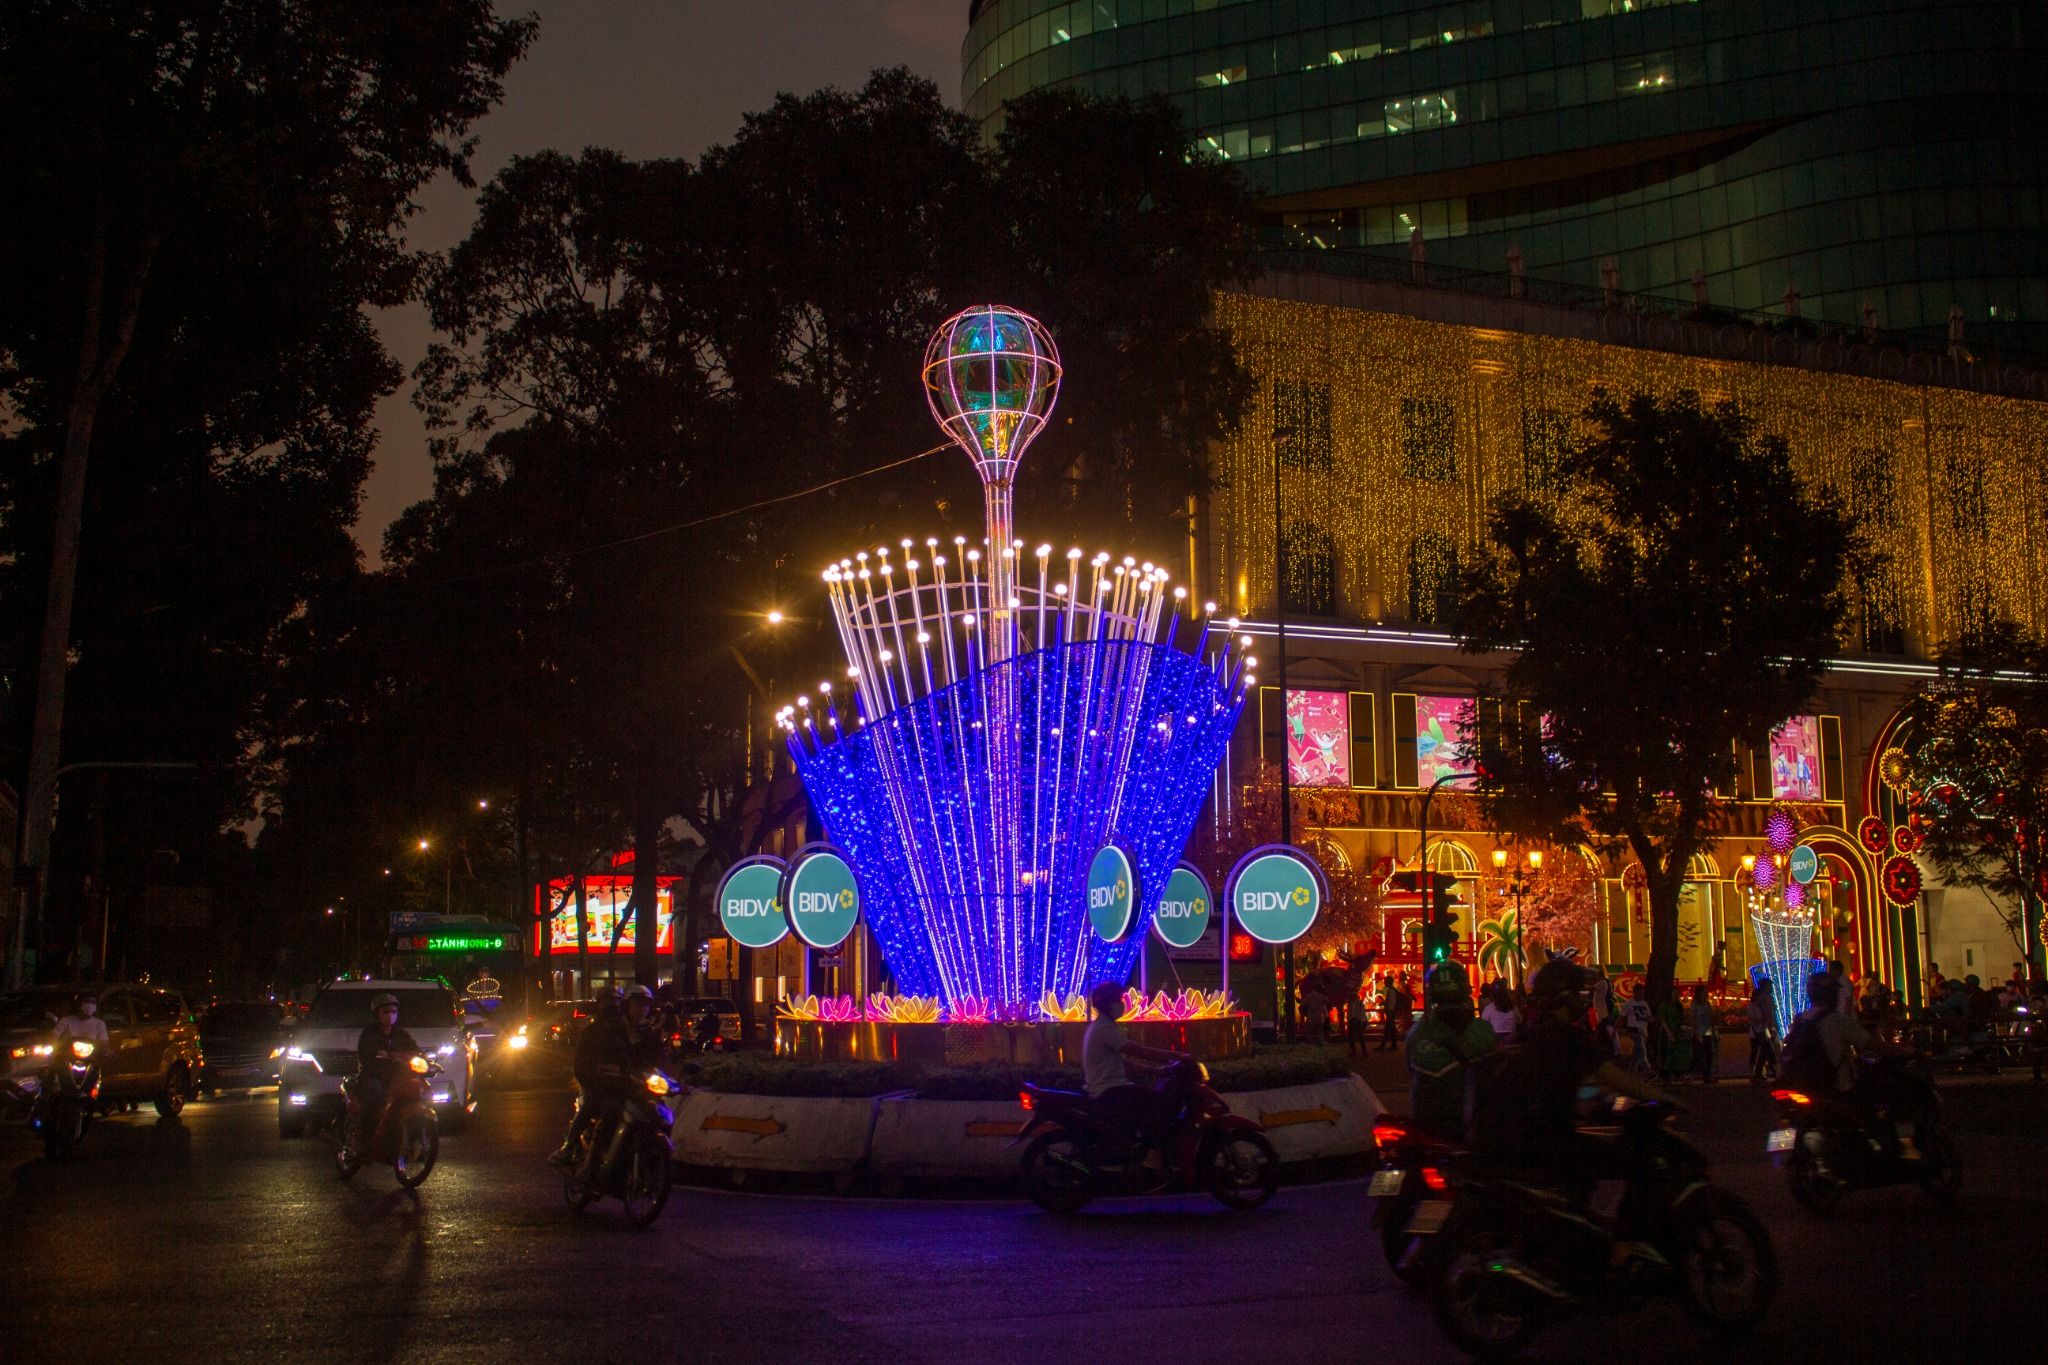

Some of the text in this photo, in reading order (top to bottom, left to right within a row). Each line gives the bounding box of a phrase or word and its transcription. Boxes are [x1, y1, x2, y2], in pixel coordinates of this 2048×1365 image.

[799, 893, 839, 912] BIDV
[1091, 885, 1116, 908] BIDV
[1243, 892, 1292, 911] BIDV
[727, 899, 771, 917] BIDV
[1160, 901, 1193, 918] BIDV
[1234, 935, 1252, 954] 36
